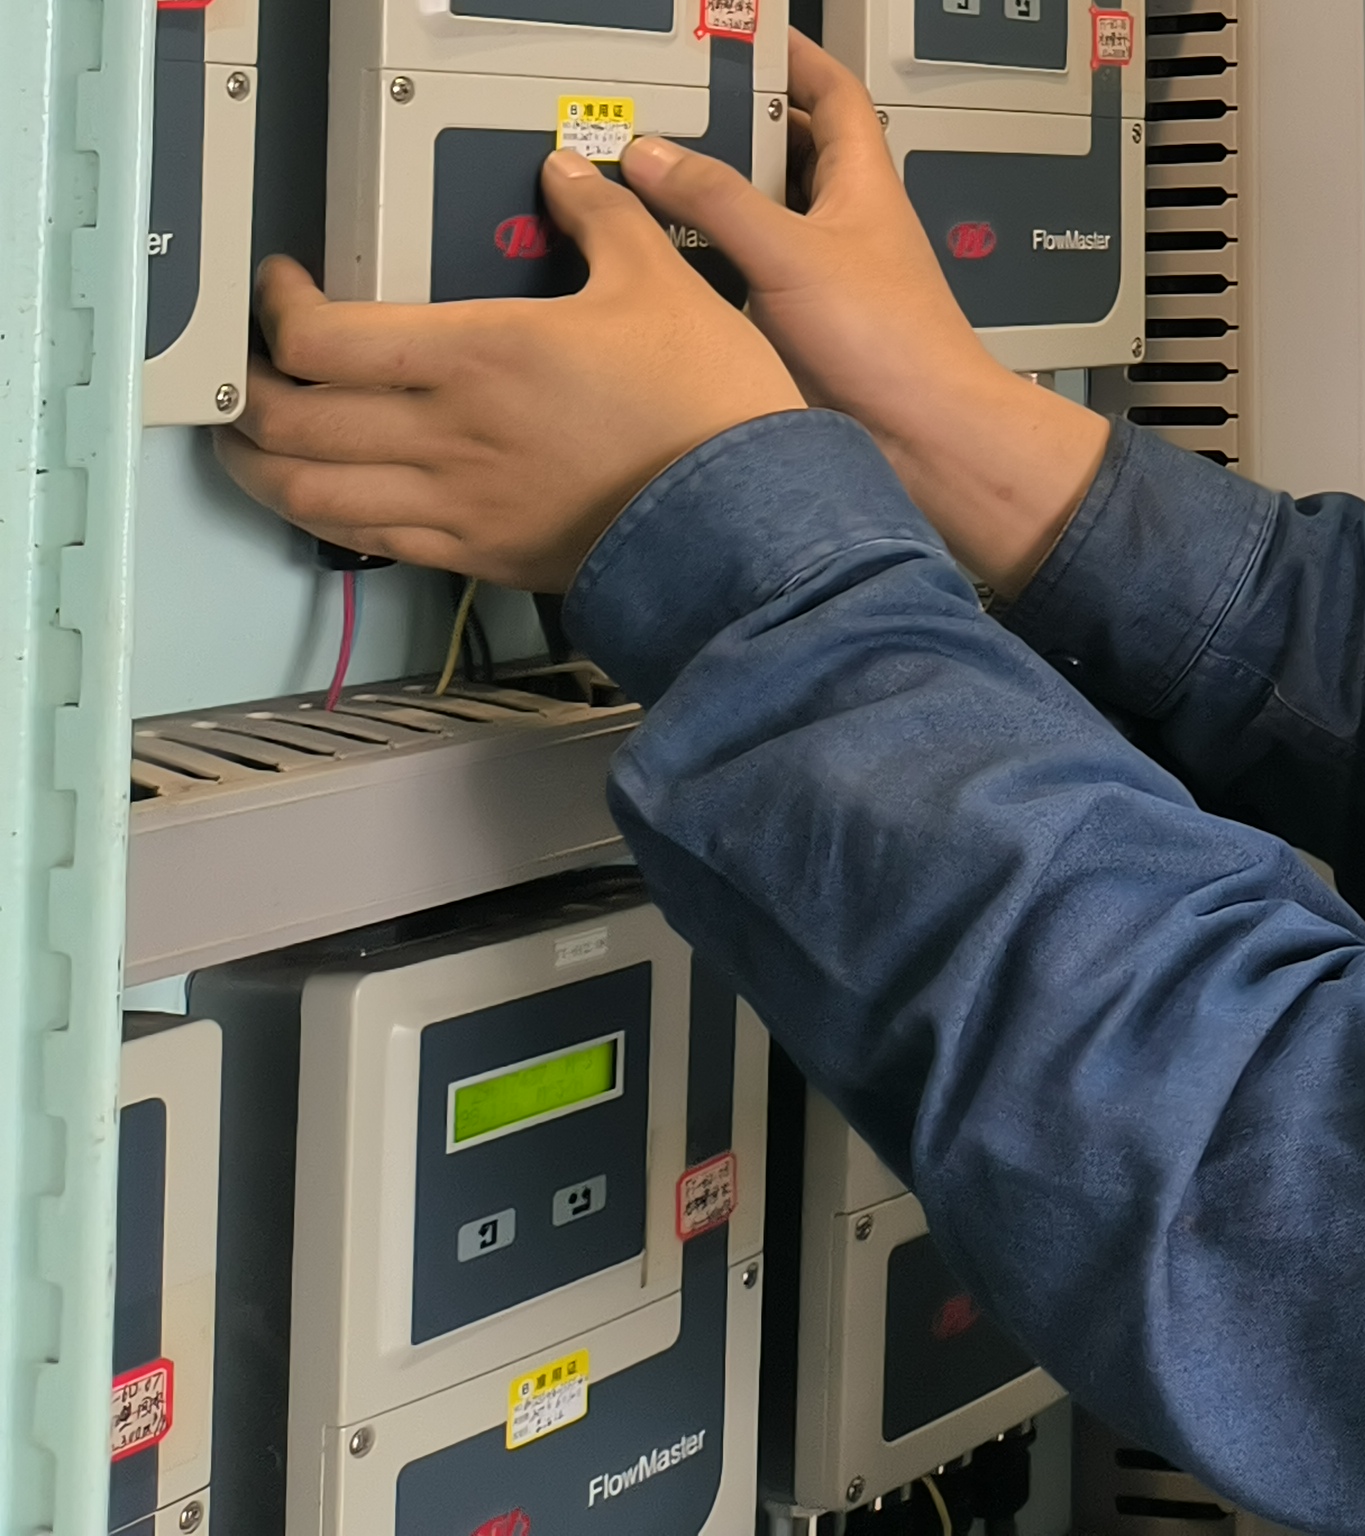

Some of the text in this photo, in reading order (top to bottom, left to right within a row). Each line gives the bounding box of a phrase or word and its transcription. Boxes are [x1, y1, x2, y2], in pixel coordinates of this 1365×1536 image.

[146, 232, 174, 255] er
[1033, 229, 1111, 250] FlowMaster
[588, 1429, 706, 1508] FlowMaster
